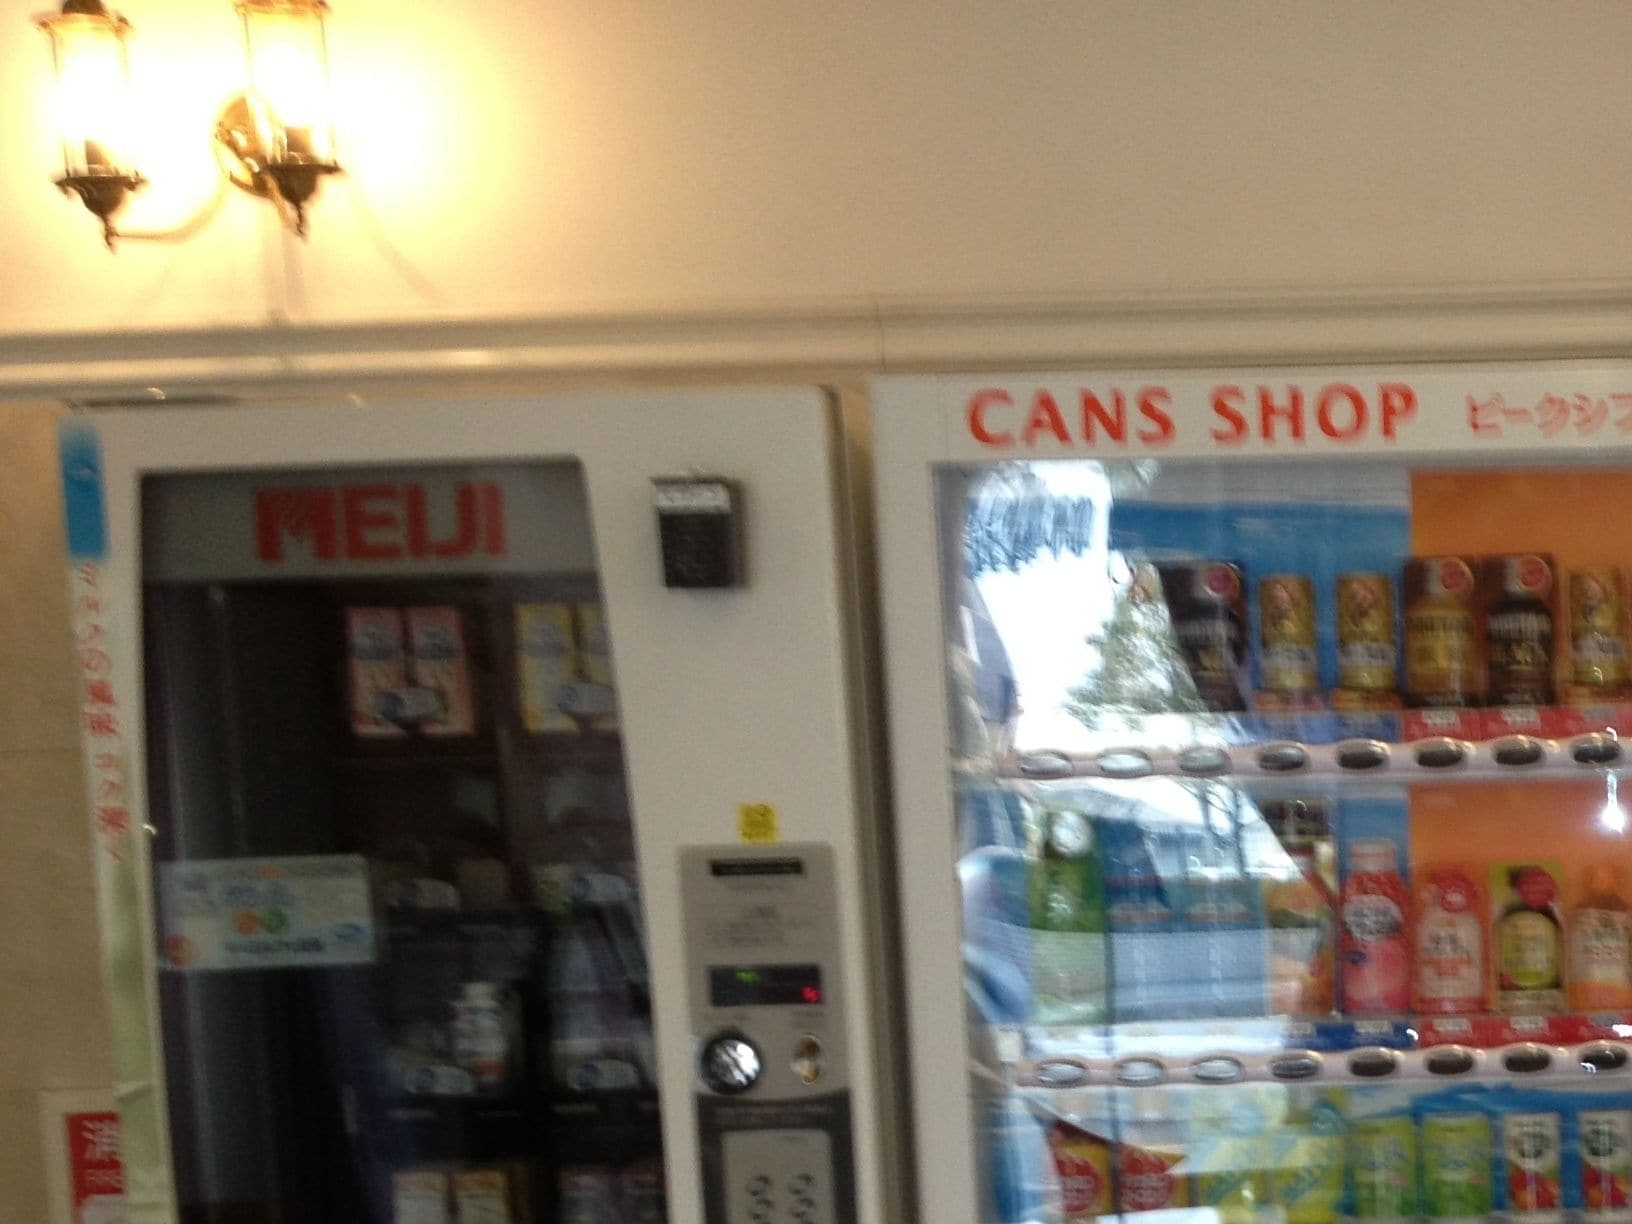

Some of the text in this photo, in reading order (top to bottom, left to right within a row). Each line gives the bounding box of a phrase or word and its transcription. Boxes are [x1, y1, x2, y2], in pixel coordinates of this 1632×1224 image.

[966, 382, 1420, 448] CANS SHOP
[256, 482, 506, 564] MEIJI
